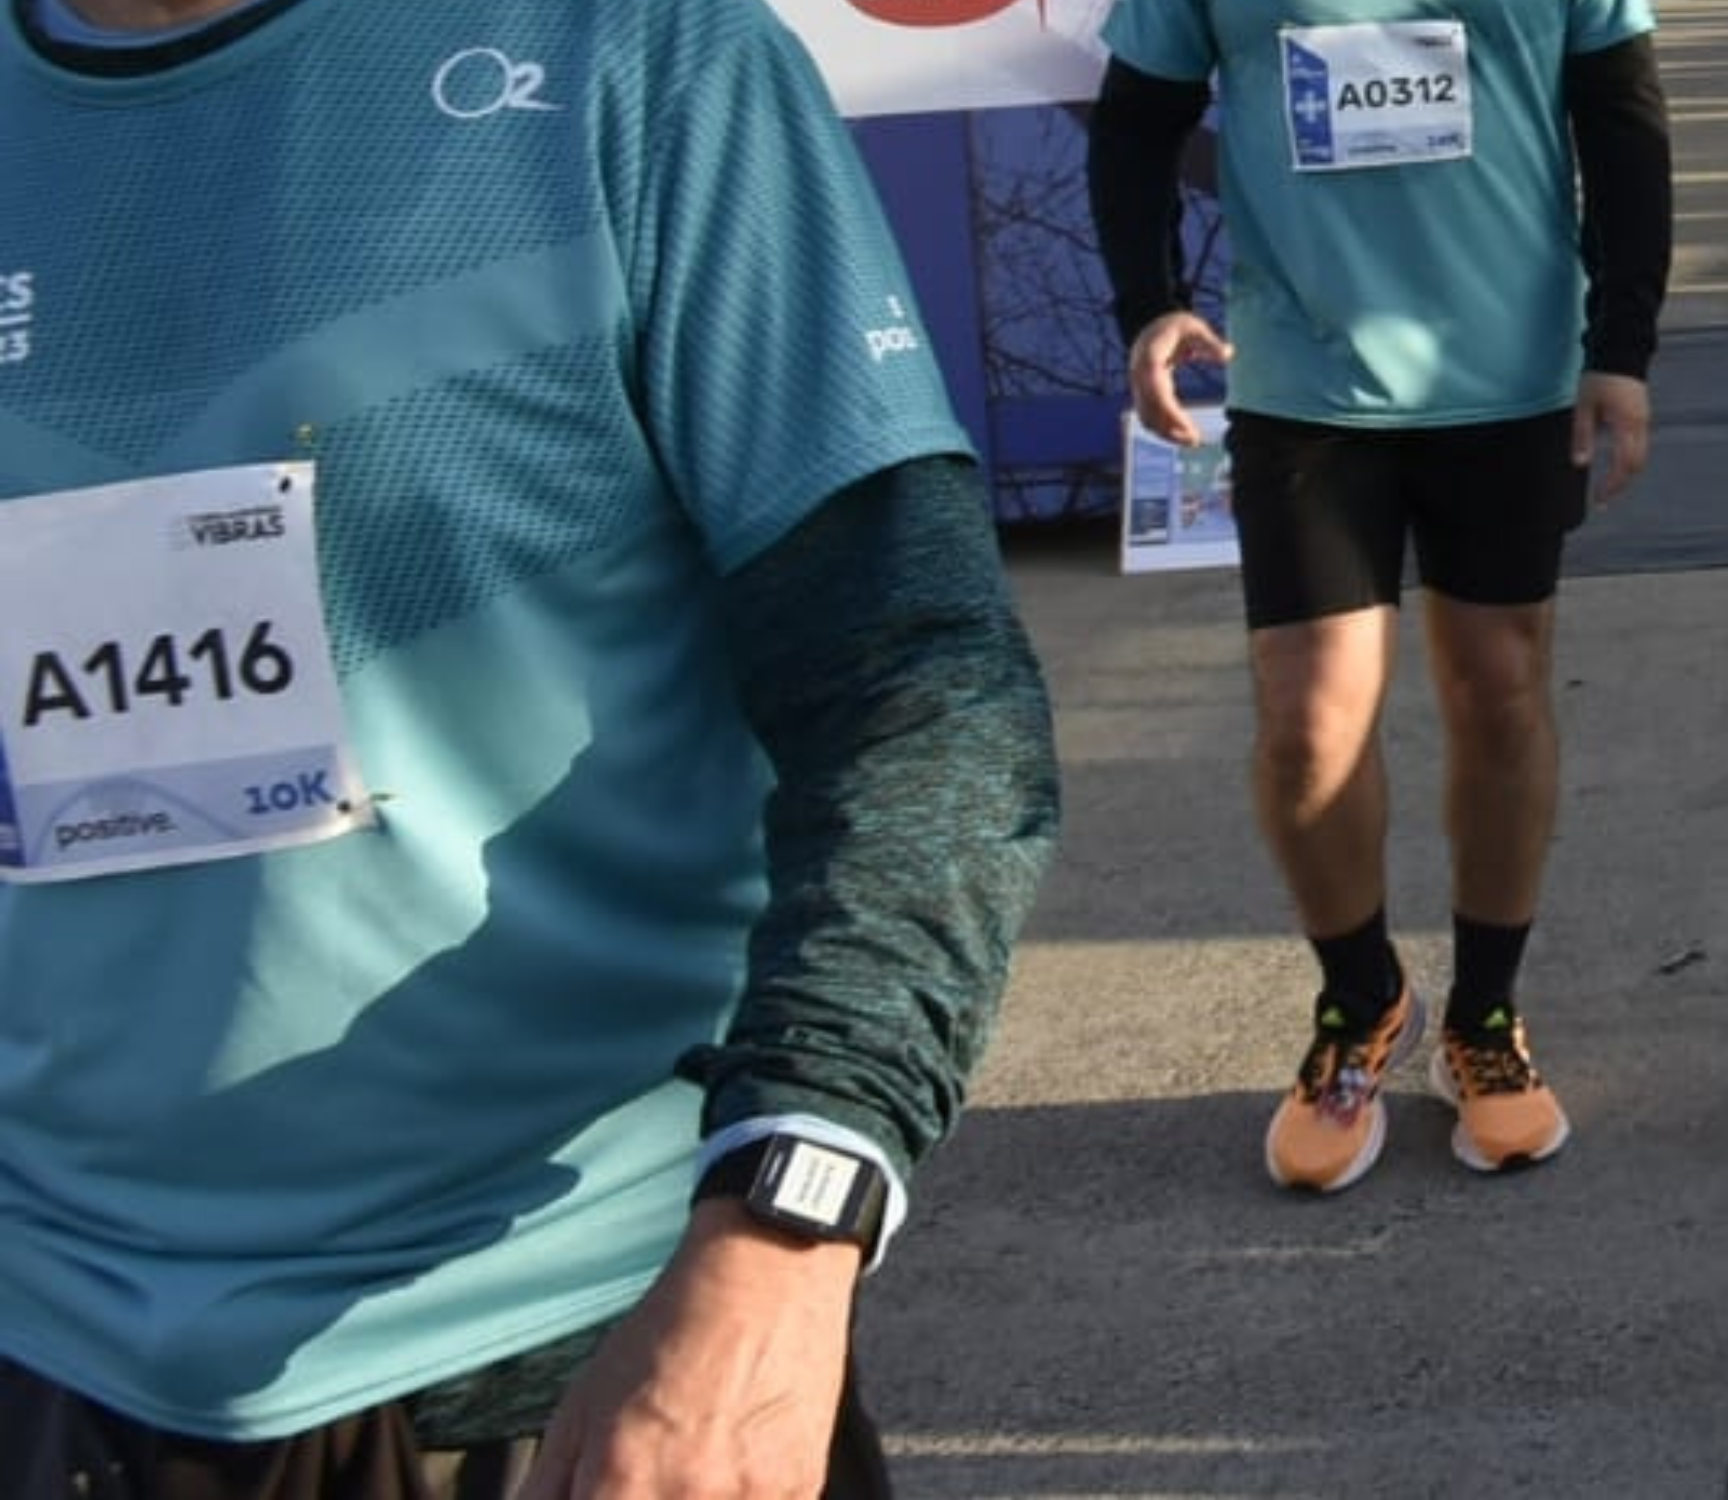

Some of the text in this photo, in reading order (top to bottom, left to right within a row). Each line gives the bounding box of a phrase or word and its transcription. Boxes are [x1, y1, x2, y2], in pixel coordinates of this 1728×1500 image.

[1337, 74, 1456, 111] A0312
[190, 513, 286, 546] VIBRAS
[22, 619, 294, 727] A1416
[244, 770, 334, 816] 10K
